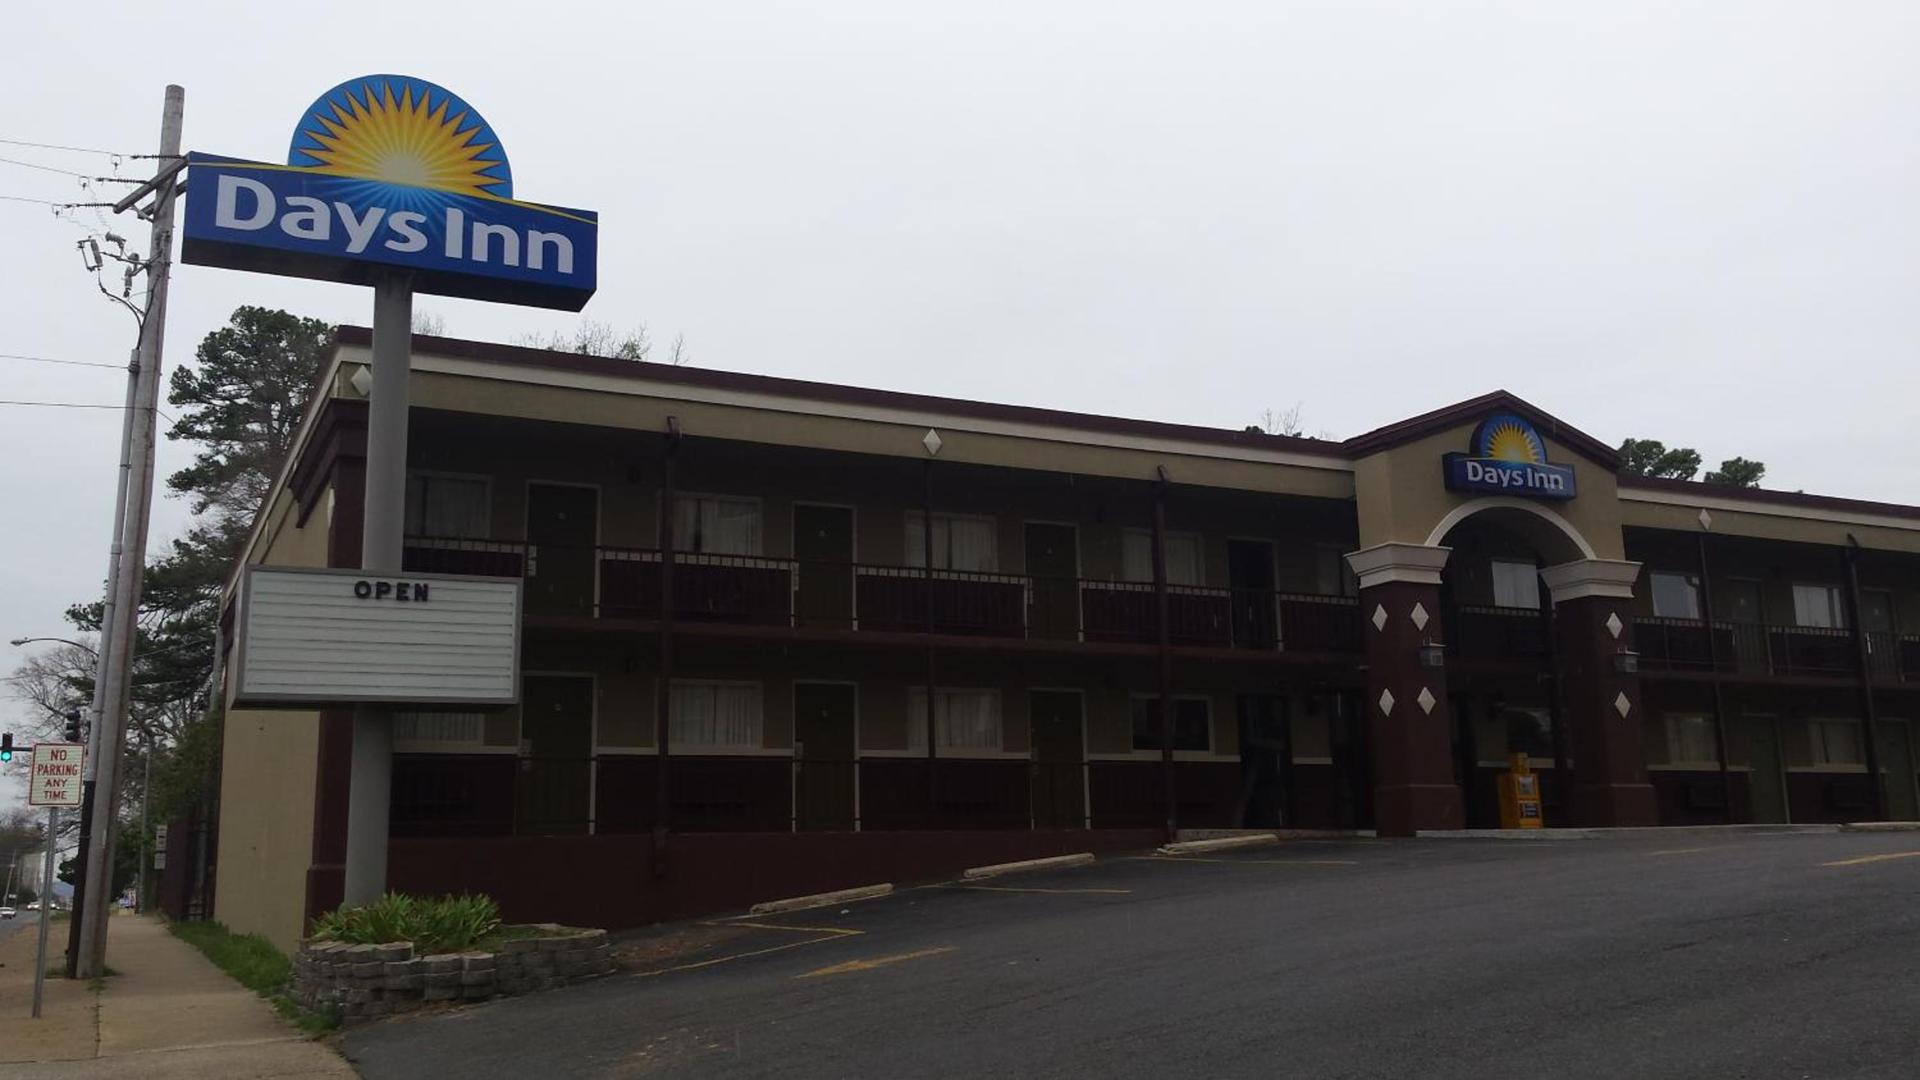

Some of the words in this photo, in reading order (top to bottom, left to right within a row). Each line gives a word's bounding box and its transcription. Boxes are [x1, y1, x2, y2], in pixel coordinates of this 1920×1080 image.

[215, 174, 429, 254] Days
[445, 207, 574, 275] Inn
[1466, 461, 1523, 487] Days
[1527, 467, 1564, 490] Inn
[354, 580, 429, 602] OPEN
[50, 749, 67, 761] NO
[36, 763, 78, 776] PARKING
[44, 778, 68, 788] ANY
[43, 790, 69, 800] TIME
